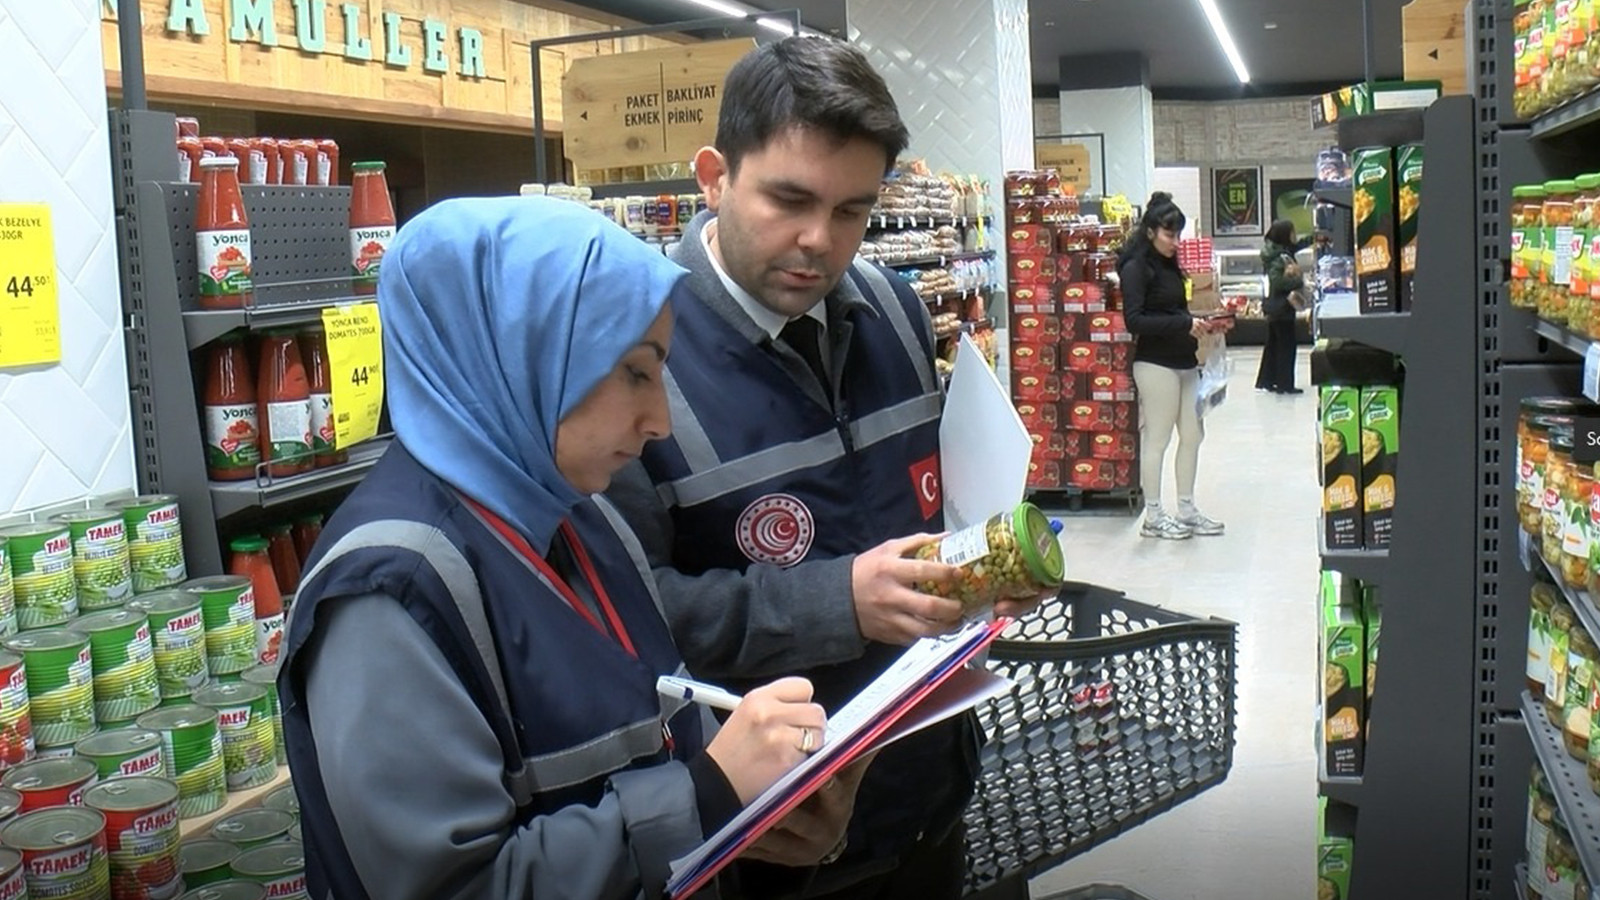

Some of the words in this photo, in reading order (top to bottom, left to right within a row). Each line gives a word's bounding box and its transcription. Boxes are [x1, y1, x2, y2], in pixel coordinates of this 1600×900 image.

[626, 93, 660, 109] PAKET
[666, 84, 716, 103] BAKLİYAT
[625, 112, 660, 127] EKMEK
[667, 107, 703, 125] PİRİNÇ
[1229, 189, 1247, 203] EN
[5, 217, 42, 228] BEZELYE
[0, 230, 24, 241] 30GR
[213, 233, 248, 246] yonca
[356, 230, 391, 242] yonca
[7, 276, 34, 298] 44
[329, 329, 358, 340] DOMATES
[352, 366, 368, 387] 44
[33, 852, 88, 875] TAMEK
